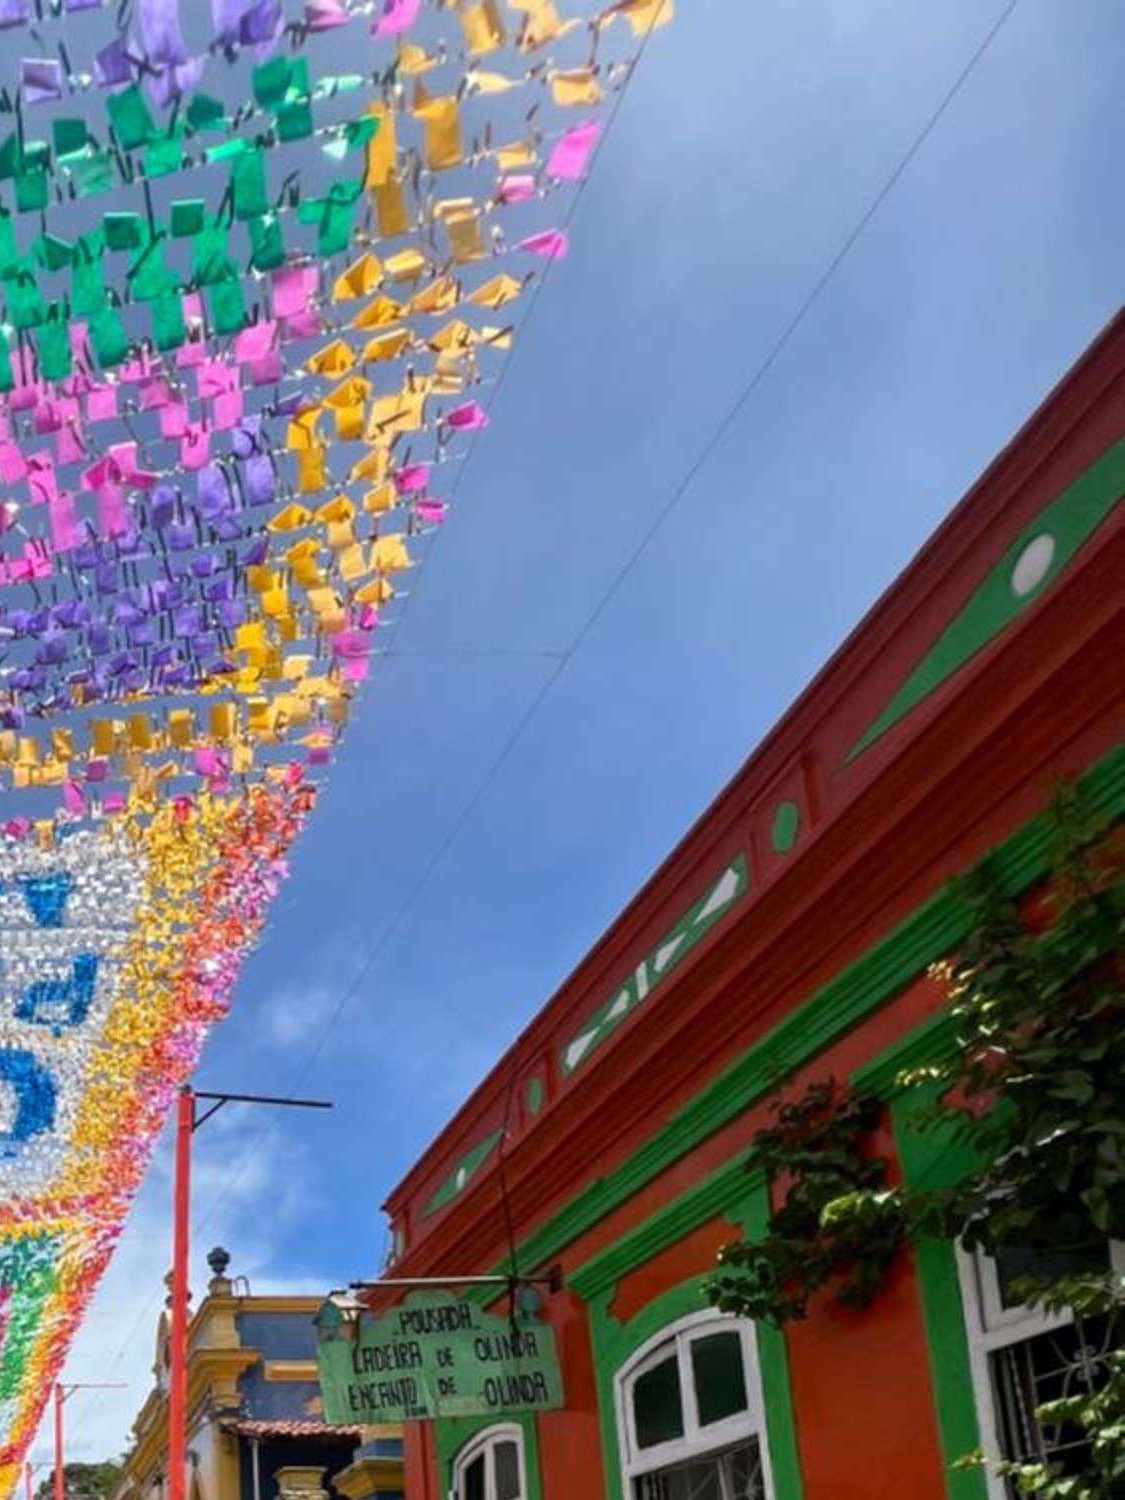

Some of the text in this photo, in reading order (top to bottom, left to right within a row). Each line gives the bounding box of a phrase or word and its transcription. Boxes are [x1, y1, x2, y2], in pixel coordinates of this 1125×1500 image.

[352, 1332, 539, 1375] LADEIRA DE OLINDA
[348, 1378, 418, 1411] ENCANTO
[438, 1377, 457, 1395] DE
